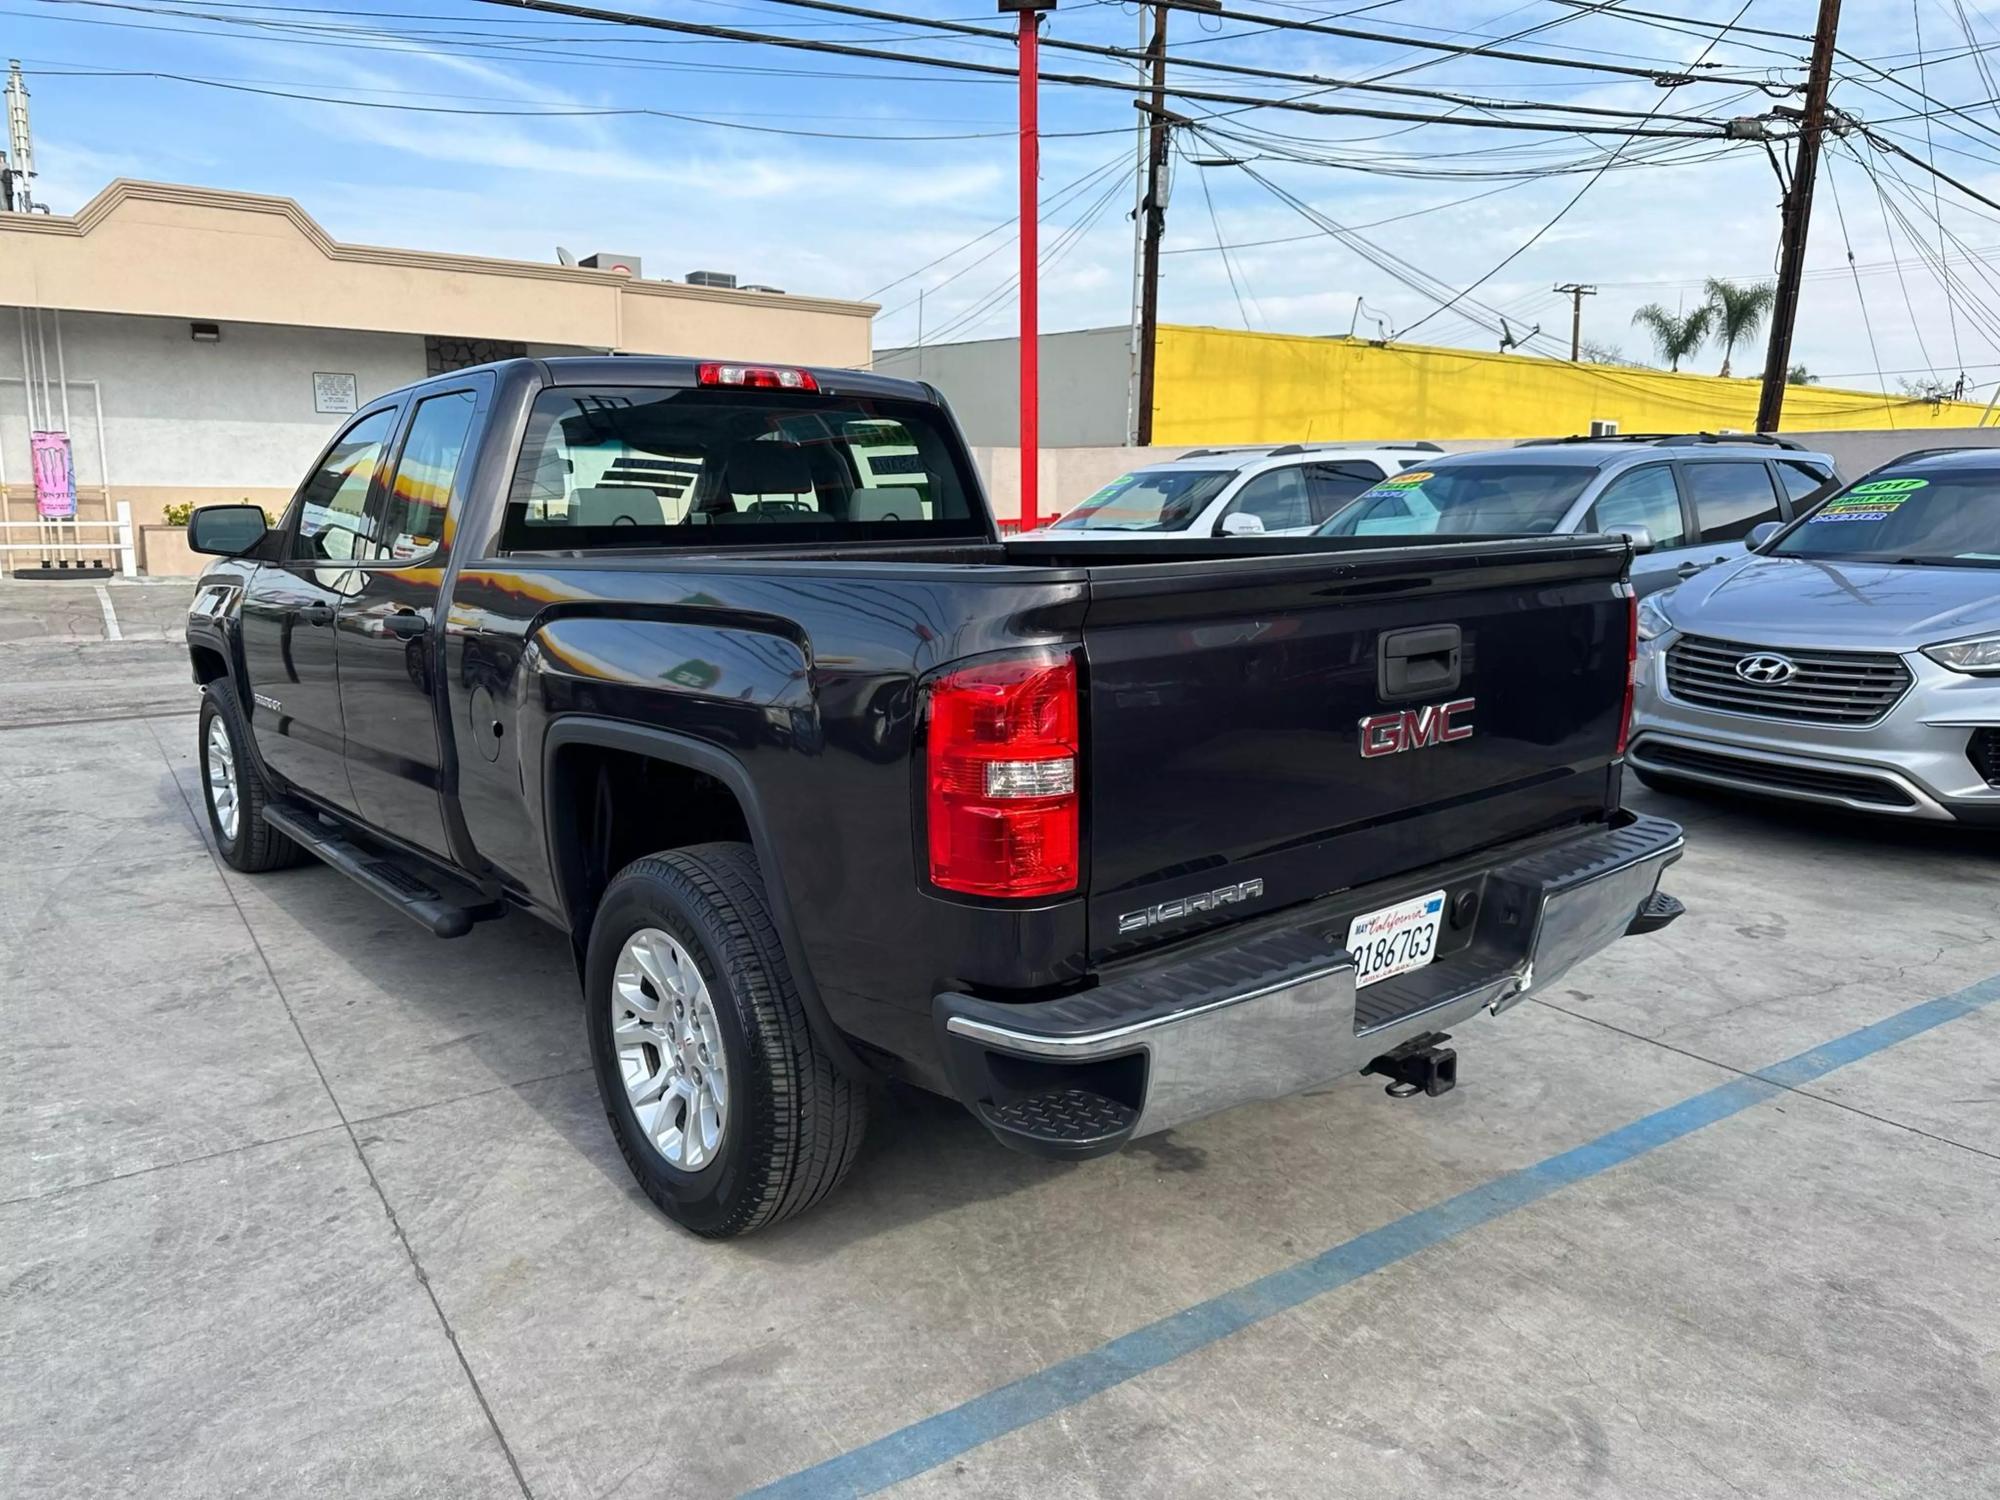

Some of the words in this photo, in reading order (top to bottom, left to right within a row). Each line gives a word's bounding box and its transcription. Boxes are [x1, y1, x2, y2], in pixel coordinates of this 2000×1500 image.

[1859, 480, 1923, 491] 2017
[1876, 495, 1909, 503] SIZE
[1358, 697, 1476, 759] GMC
[1118, 877, 1264, 935] SIERRA
[1355, 923, 1369, 936] MAY
[1369, 909, 1425, 935] California
[1353, 922, 1434, 977] 81867G3
